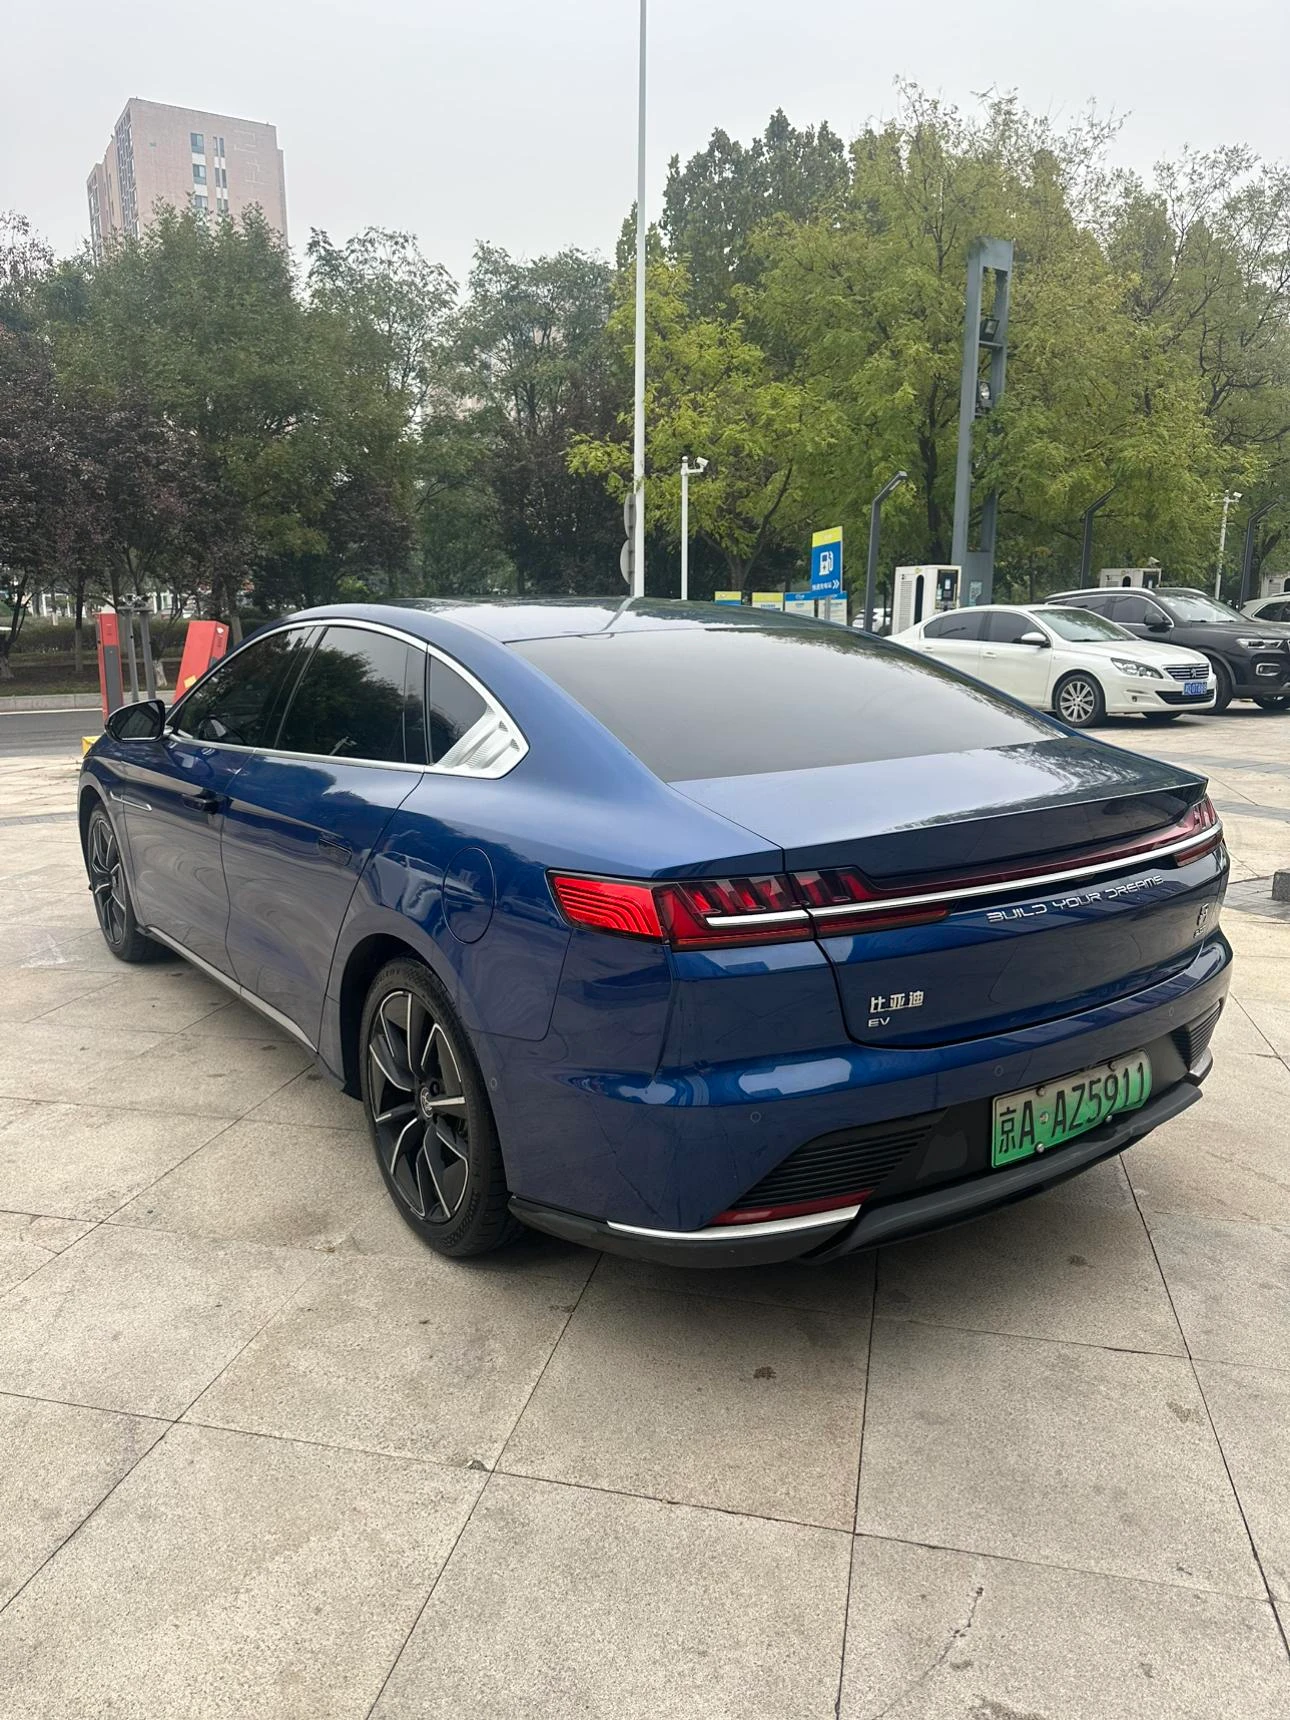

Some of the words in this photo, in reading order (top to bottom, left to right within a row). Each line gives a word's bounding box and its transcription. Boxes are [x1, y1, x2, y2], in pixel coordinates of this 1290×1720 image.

[986, 904, 1048, 923] BUILD
[1052, 892, 1102, 909] YOUR
[1104, 875, 1165, 899] DREAMS
[870, 990, 924, 1013] 比亚迪
[868, 1017, 891, 1028] EV
